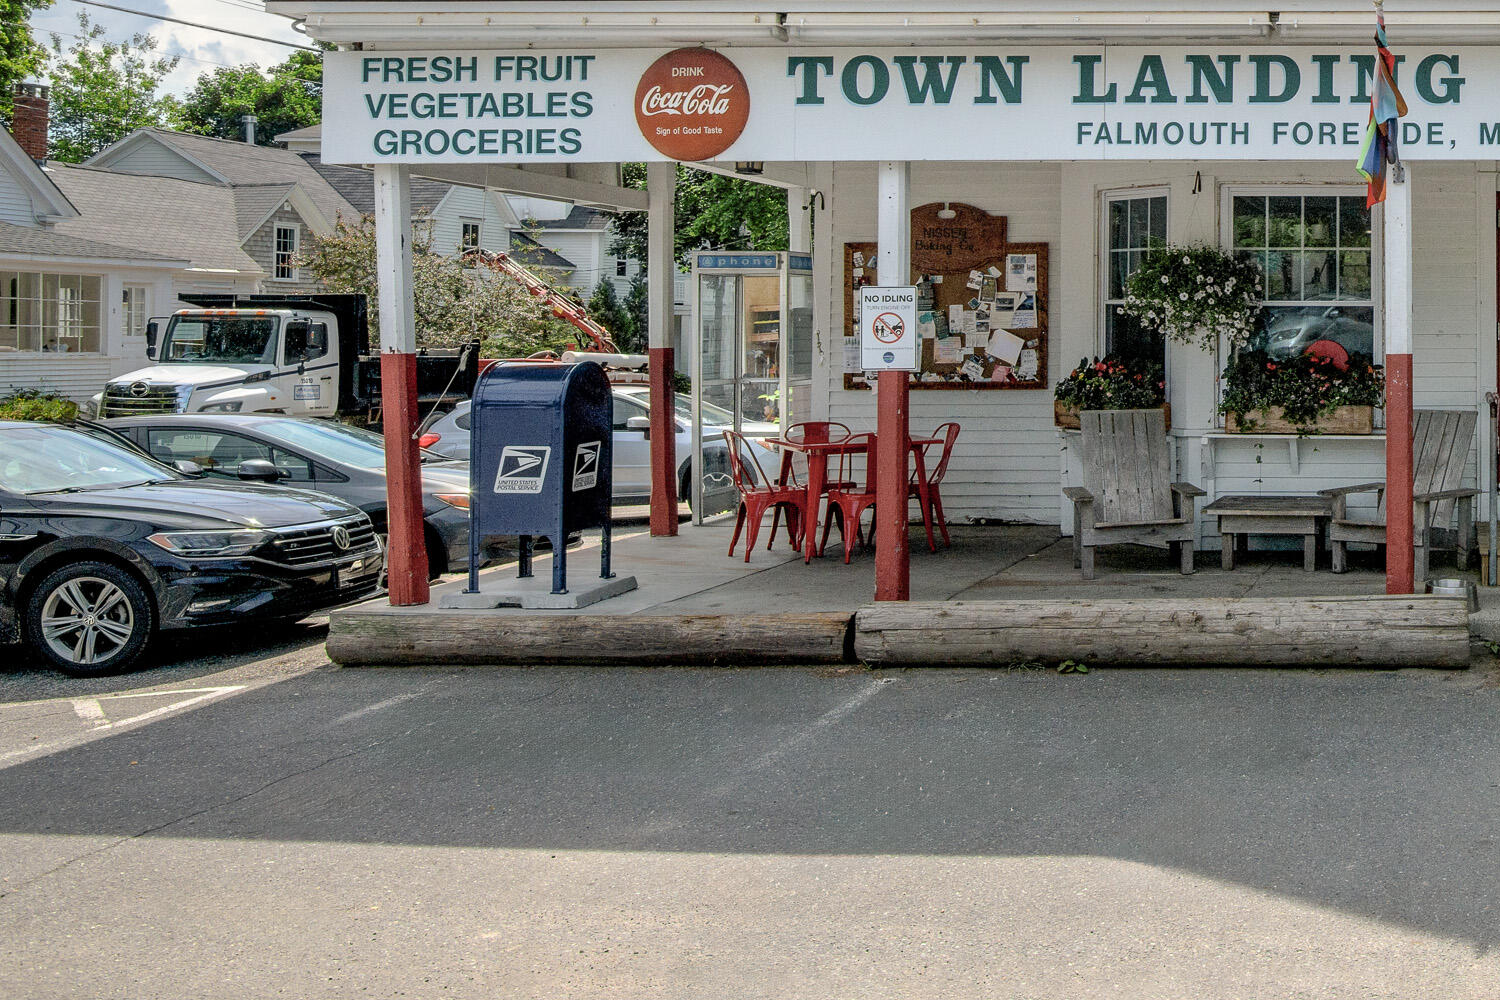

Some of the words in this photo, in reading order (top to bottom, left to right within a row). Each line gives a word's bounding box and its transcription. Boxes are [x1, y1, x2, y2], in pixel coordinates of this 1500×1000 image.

[362, 56, 478, 83] FRESH
[495, 55, 596, 81] FRUIT
[671, 66, 705, 77] DRINK
[787, 55, 1031, 106] TOWN
[1072, 53, 1466, 104] LANDING
[364, 91, 594, 119] VEGETABLES
[641, 84, 734, 117] Coca-Cola
[373, 127, 582, 156] GROCERIES
[656, 126, 671, 137] Sign
[673, 127, 681, 135] of
[682, 126, 702, 135] Good
[703, 126, 723, 134] Taste
[1077, 121, 1249, 145] FALMOUTH
[1273, 121, 1456, 150] FOREDE,
[718, 257, 773, 268] phone
[864, 295, 880, 303] NO
[882, 295, 914, 303] IDLING
